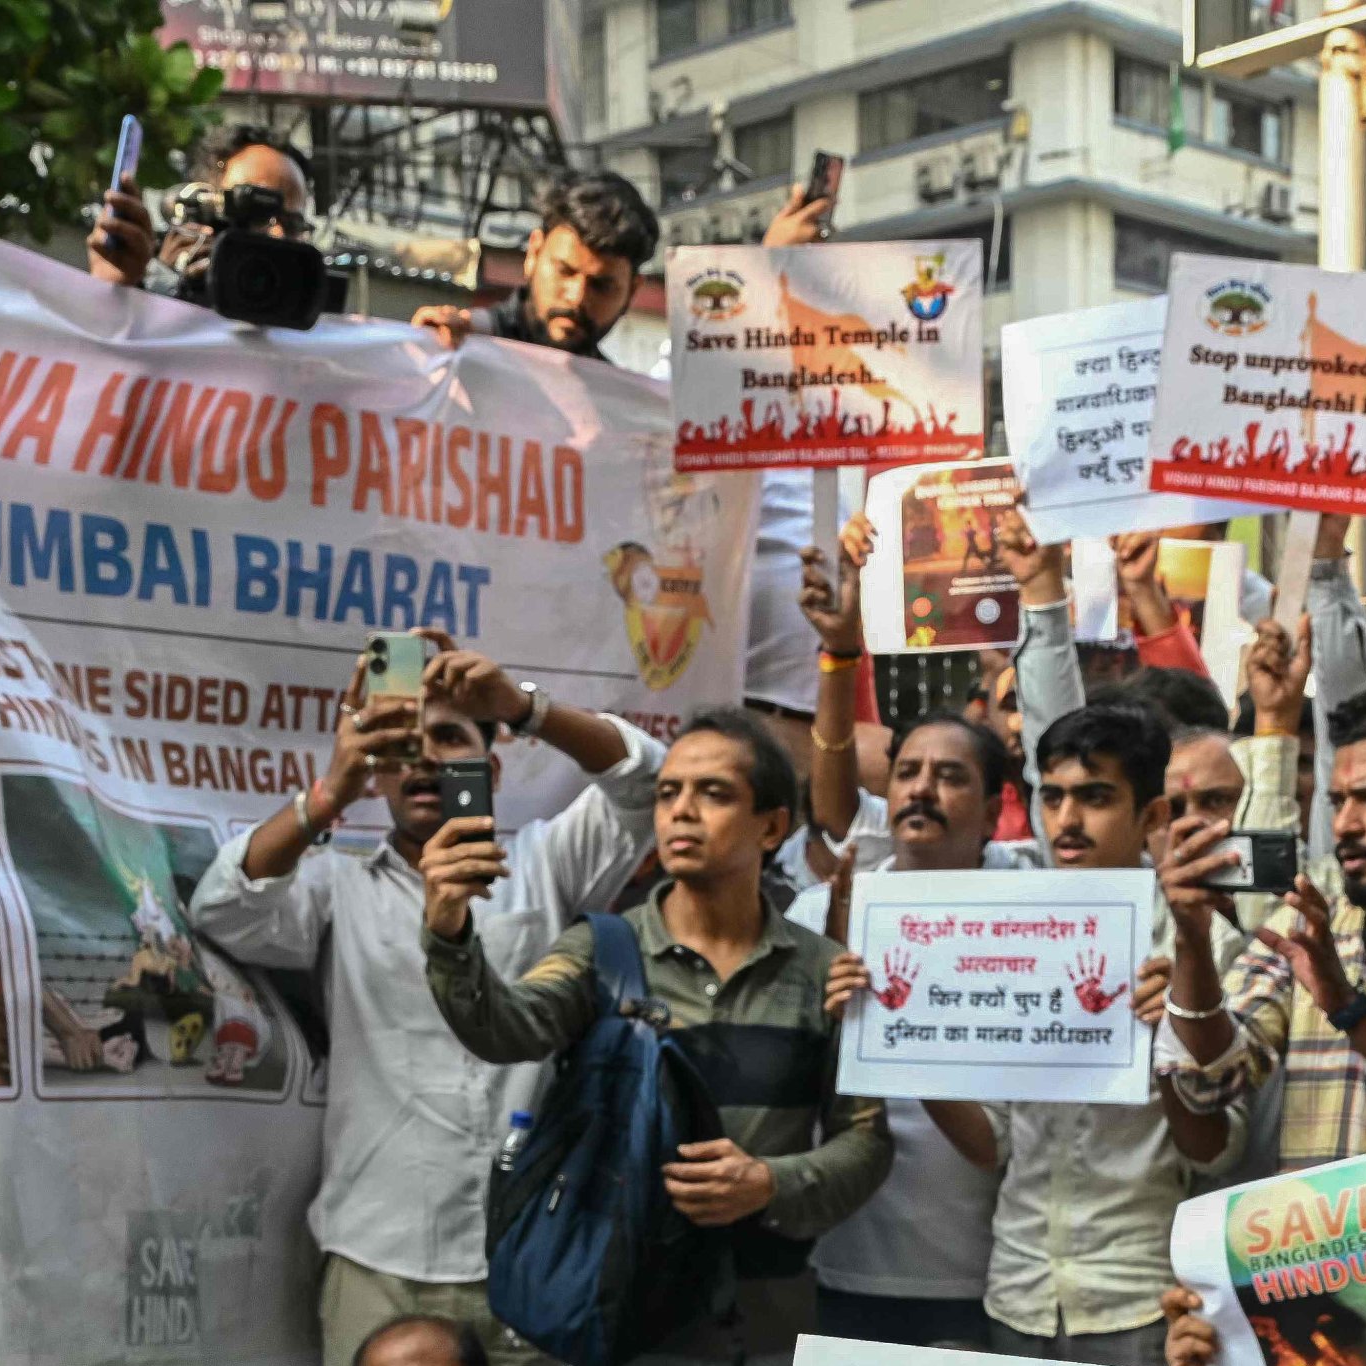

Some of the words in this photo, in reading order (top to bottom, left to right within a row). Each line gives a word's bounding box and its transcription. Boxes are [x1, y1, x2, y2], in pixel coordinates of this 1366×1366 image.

[685, 328, 737, 351] Save
[744, 326, 815, 349] Hindu
[824, 322, 909, 351] Temple
[916, 320, 939, 344] in
[1189, 344, 1238, 371] Stop
[1223, 384, 1355, 413] Bangladeshi
[72, 373, 299, 502] HINDU
[309, 402, 585, 543] PARISHAD
[234, 532, 492, 637] BHARAT
[123, 669, 250, 726] SIDED
[111, 736, 156, 783] IN
[962, 919, 985, 938] पर
[990, 915, 1076, 942] बांग्लादेश
[954, 955, 1038, 974] अत्याचार
[928, 983, 963, 1007] फिर
[968, 985, 1007, 1008] क्यों
[1013, 990, 1042, 1016] चुप
[883, 1018, 938, 1049] दुनिया
[944, 1025, 969, 1044] का
[975, 1025, 1024, 1044] मानव
[1029, 1020, 1113, 1046] अधिकार
